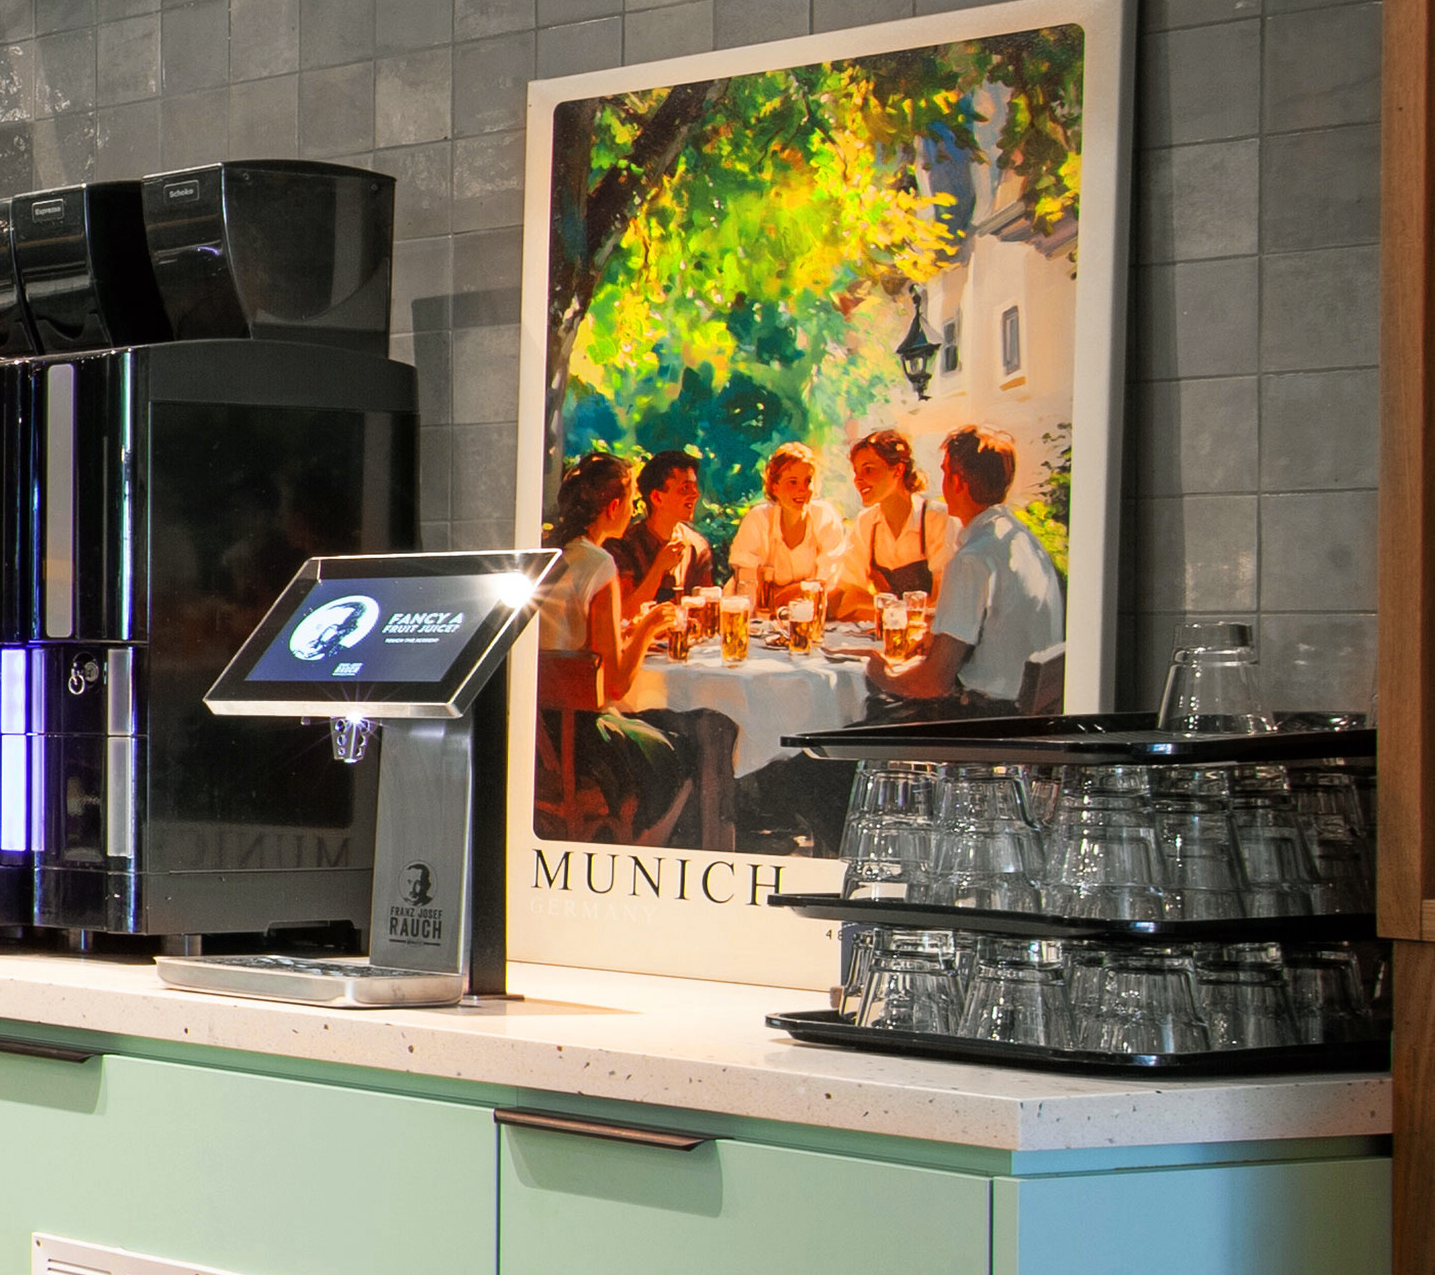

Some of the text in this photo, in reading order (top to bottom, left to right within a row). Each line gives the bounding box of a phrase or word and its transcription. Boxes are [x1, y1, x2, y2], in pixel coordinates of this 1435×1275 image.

[388, 612, 464, 624] FANCY A
[381, 624, 461, 633] FRUIT JUICE?
[530, 848, 787, 908] MUNICH
[390, 906, 444, 920] FRANZ JOSEF
[528, 897, 660, 925] GERMANY
[389, 917, 443, 940] RAUCH
